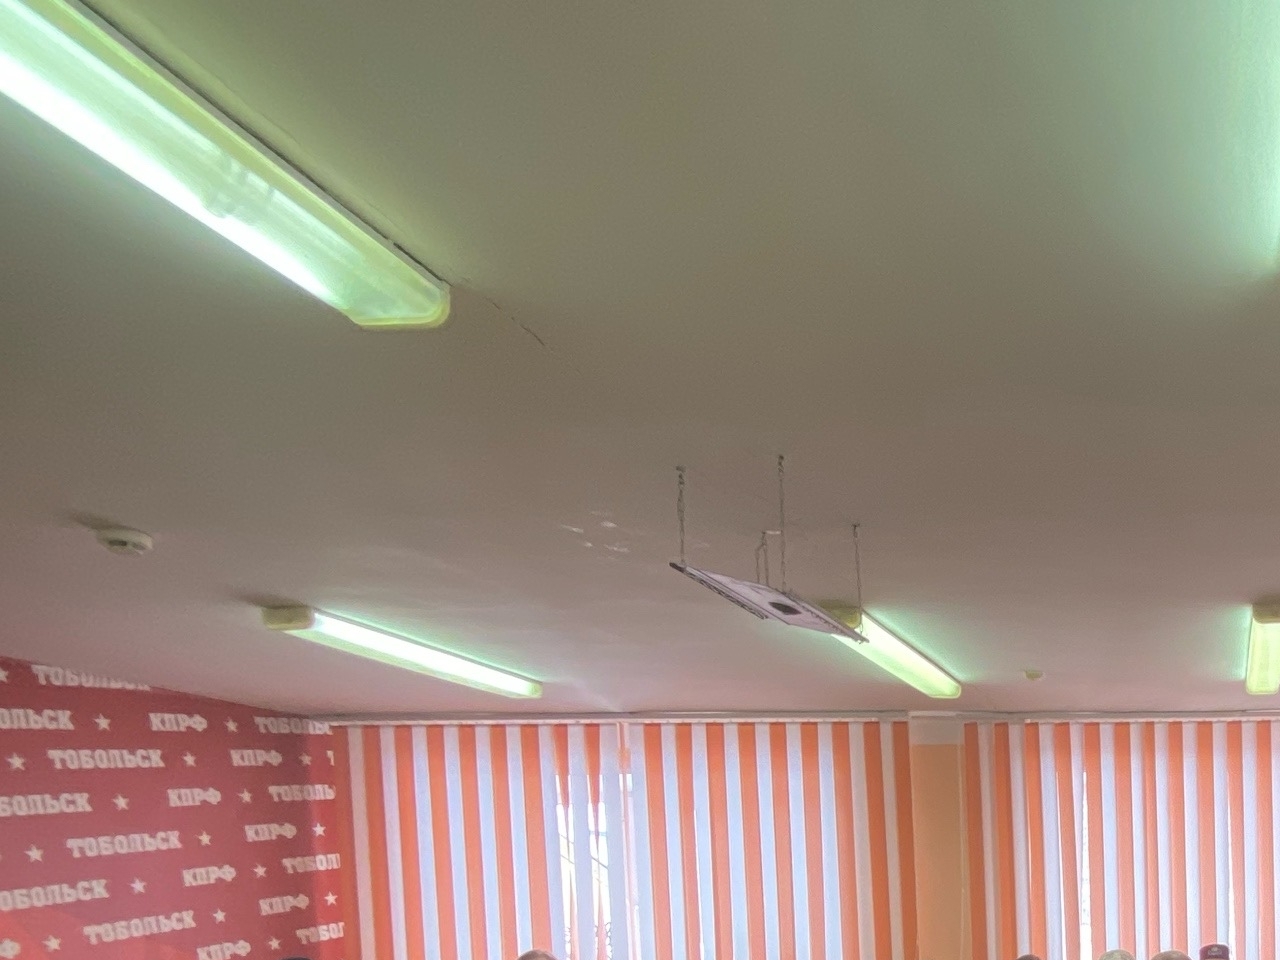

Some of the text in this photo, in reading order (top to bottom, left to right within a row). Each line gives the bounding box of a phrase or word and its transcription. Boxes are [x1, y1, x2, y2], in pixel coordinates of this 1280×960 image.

[149, 713, 207, 732] КПРФ
[47, 749, 165, 769] ТОБОЛЬСК
[230, 749, 282, 766] КПРФ
[168, 787, 221, 807] КПРФ
[268, 784, 336, 802] ТОБОЛЬ
[66, 824, 297, 858] ТОБОЛЬСК КПРФ
[183, 865, 236, 887] КПРФ
[282, 853, 340, 874] ТОБОЛ
[83, 910, 196, 945] ТОБОЛЬСК
[259, 893, 309, 916] КПРФ
